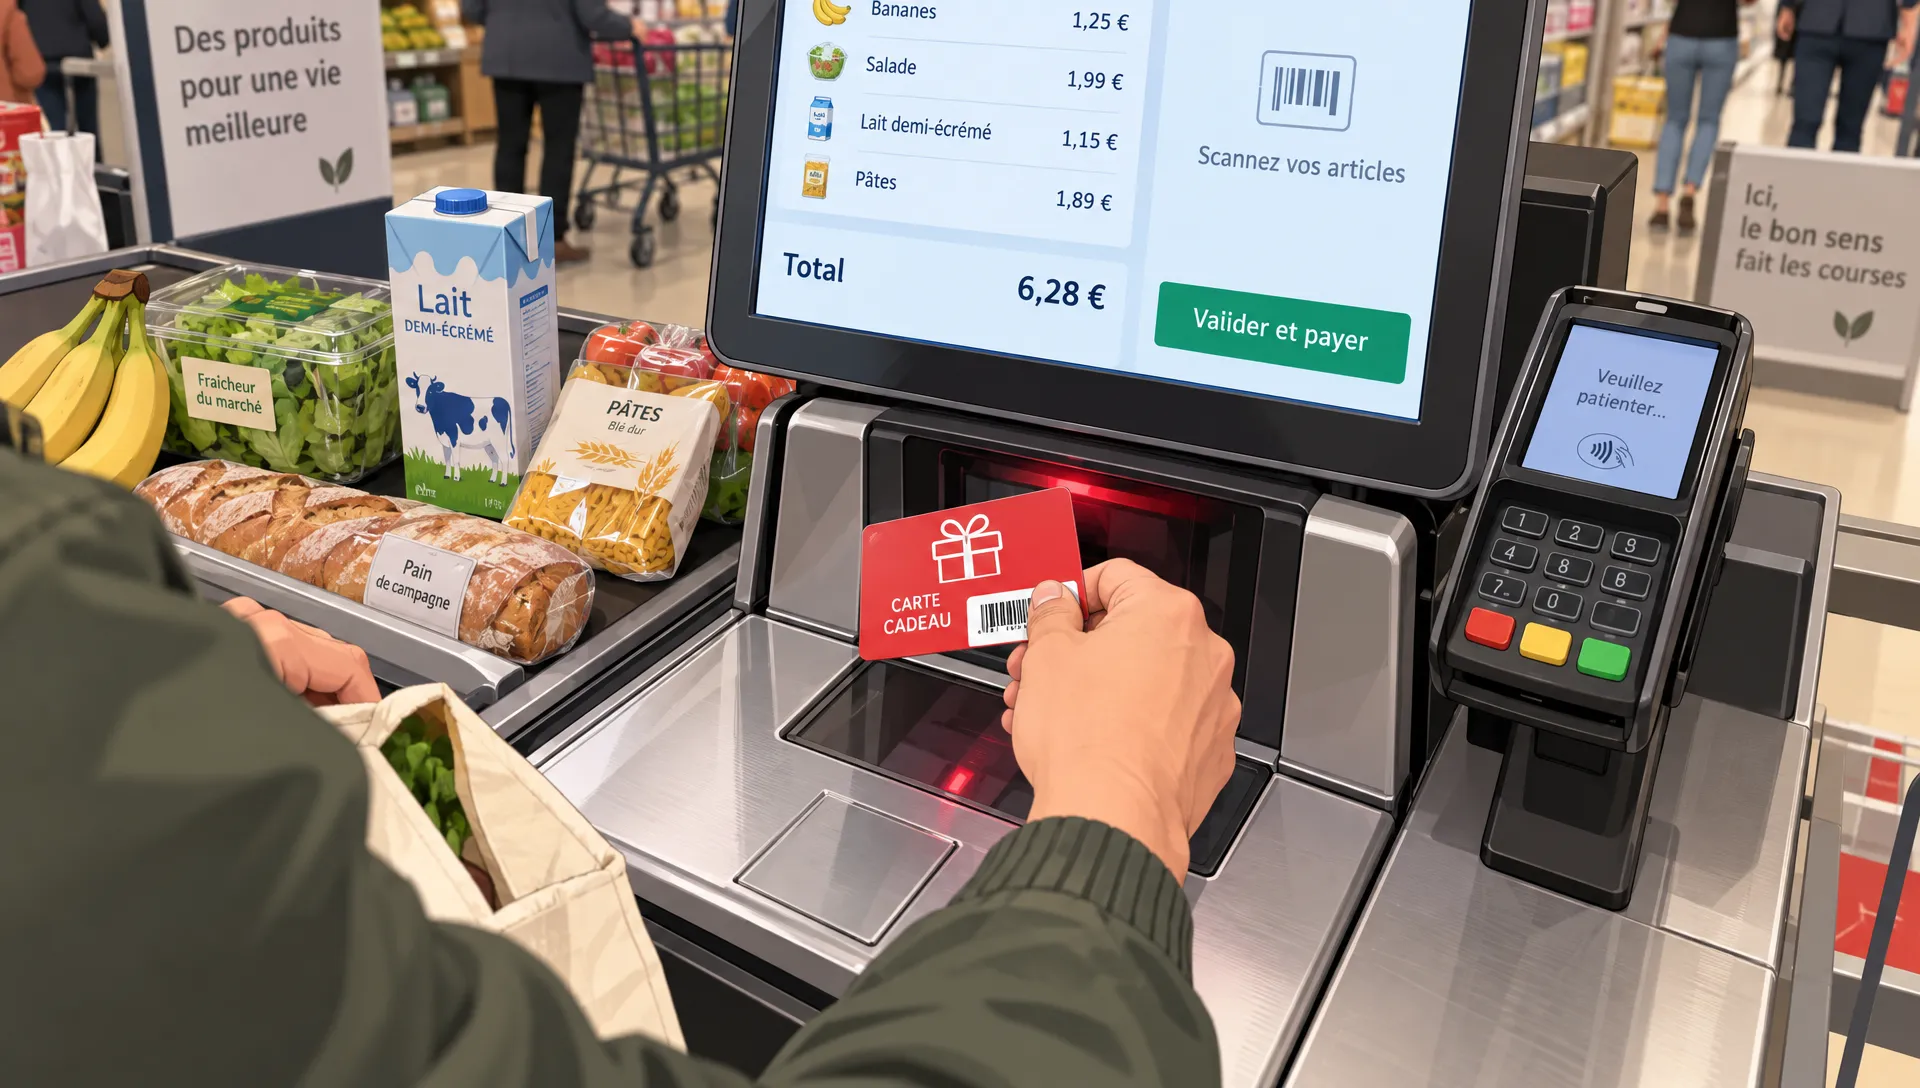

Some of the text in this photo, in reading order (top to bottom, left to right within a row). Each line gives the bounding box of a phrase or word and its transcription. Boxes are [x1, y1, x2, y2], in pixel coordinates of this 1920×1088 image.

[871, 0, 937, 19] Bananes
[1072, 11, 1130, 31] 1,25 €
[174, 16, 342, 57] Des produits
[866, 56, 918, 75] Salade
[180, 58, 342, 108] pour une vie
[1067, 70, 1124, 91] 1,99 €
[185, 110, 308, 147] meilleure
[860, 113, 993, 141] Lait demi-écrémé
[1062, 129, 1119, 151] 1,15 €
[1197, 145, 1407, 184] Scannez vos articles
[855, 170, 898, 190] Pâtes
[1056, 190, 1113, 212] 1,89 €
[1745, 182, 1779, 212] Ici,
[1740, 215, 1885, 255] le bon sens
[783, 252, 845, 283] Total
[1735, 247, 1908, 290] fait les courses
[417, 284, 473, 318] Lait
[1017, 275, 1106, 311] 6,28 €
[404, 318, 495, 344] DEMI-ÉCRÉMÉ
[1275, 322, 1299, 342] et
[1303, 328, 1369, 354] payer
[197, 372, 256, 394] Fraicheur
[1598, 367, 1664, 395] Veuillez
[196, 390, 262, 415] du marché
[606, 399, 664, 423] PÂTES
[607, 420, 647, 436] Blé dur
[1518, 513, 1527, 528] 1
[1568, 525, 1581, 541] 2
[1504, 545, 1516, 561] 4
[403, 559, 433, 582] Pain
[1557, 558, 1570, 574] 8
[375, 574, 451, 610] de campagne
[1493, 578, 1504, 595] 7
[891, 592, 941, 613] CARTE
[1546, 593, 1560, 609] 0
[883, 612, 951, 635] CADEAU
